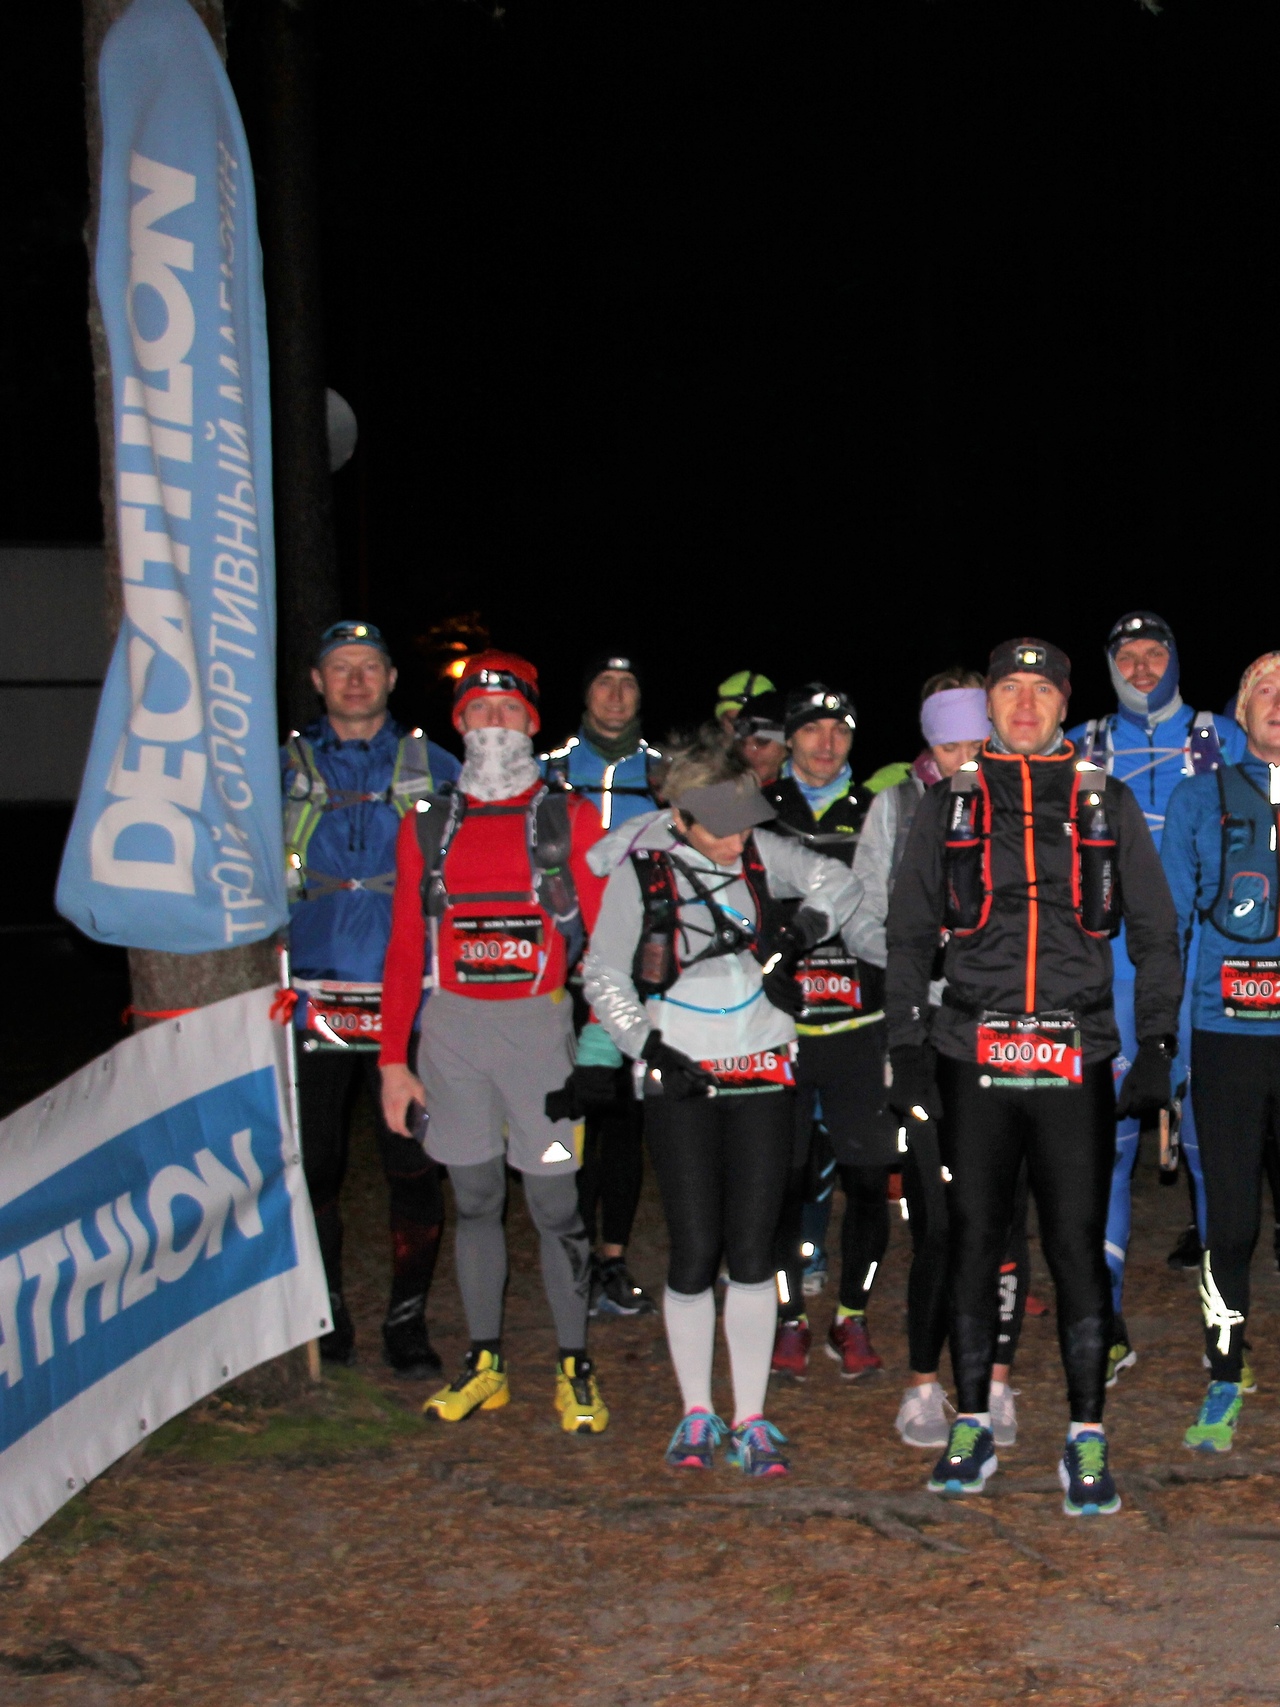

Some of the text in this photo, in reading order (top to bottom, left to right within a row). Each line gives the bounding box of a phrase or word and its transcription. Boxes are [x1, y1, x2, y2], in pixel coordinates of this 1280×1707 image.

[90, 150, 206, 897] DECATHLON
[461, 939, 533, 962] 10020
[801, 976, 852, 993] 0006
[319, 1012, 382, 1032] 0032
[712, 1051, 779, 1073] 10016
[988, 1041, 1068, 1064] 10007
